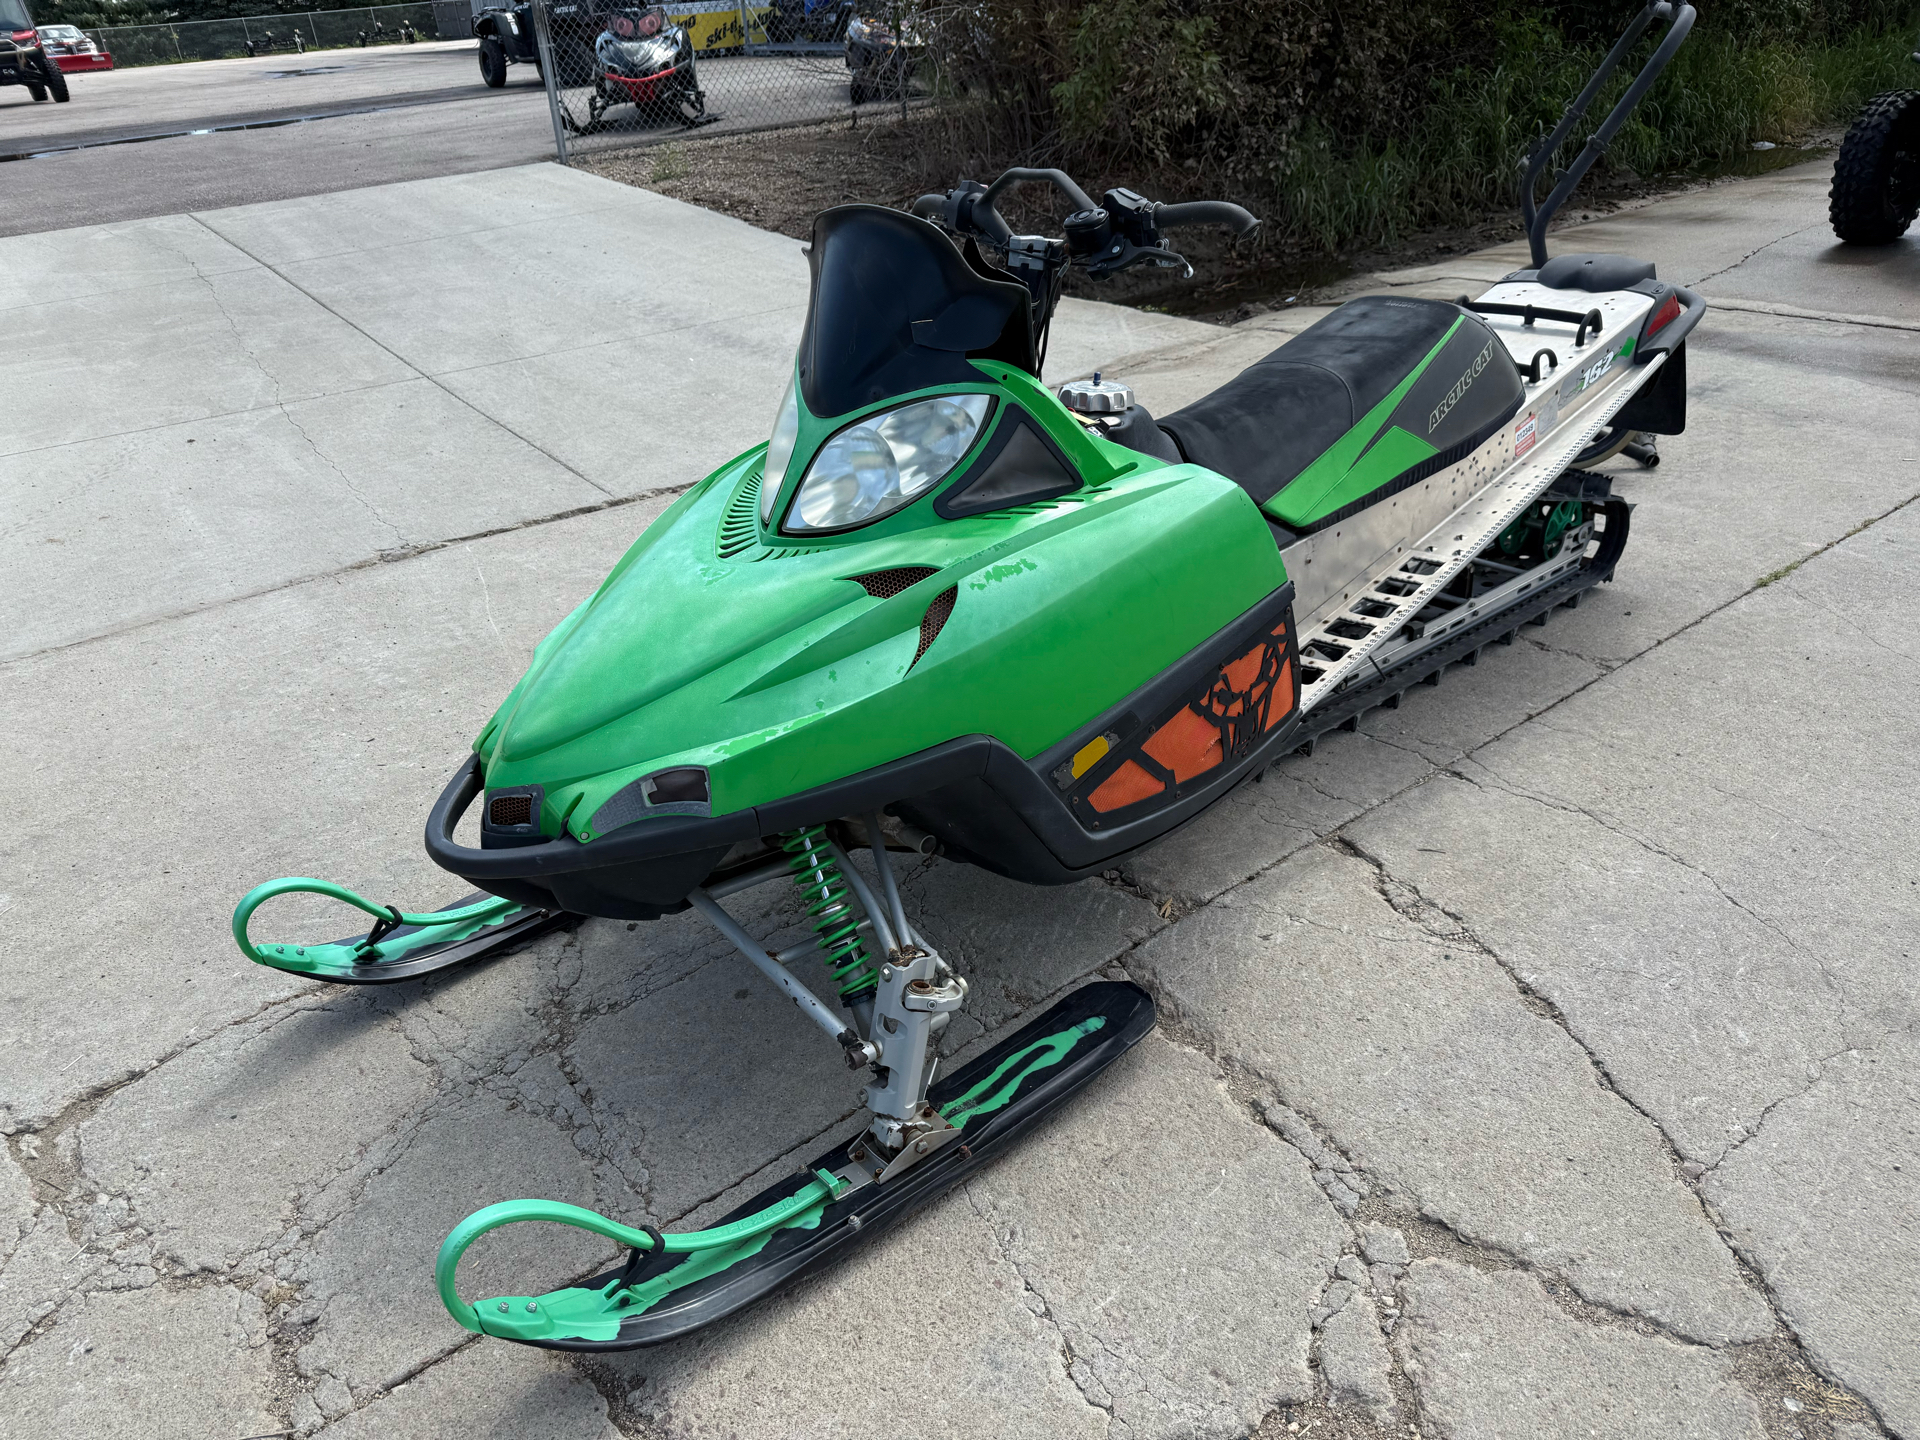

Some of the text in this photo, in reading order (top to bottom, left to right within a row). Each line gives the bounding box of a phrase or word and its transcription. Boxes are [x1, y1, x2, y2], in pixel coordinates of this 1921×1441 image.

[1428, 339, 1493, 434] ARCTIC CAT
[1582, 351, 1614, 390] 162
